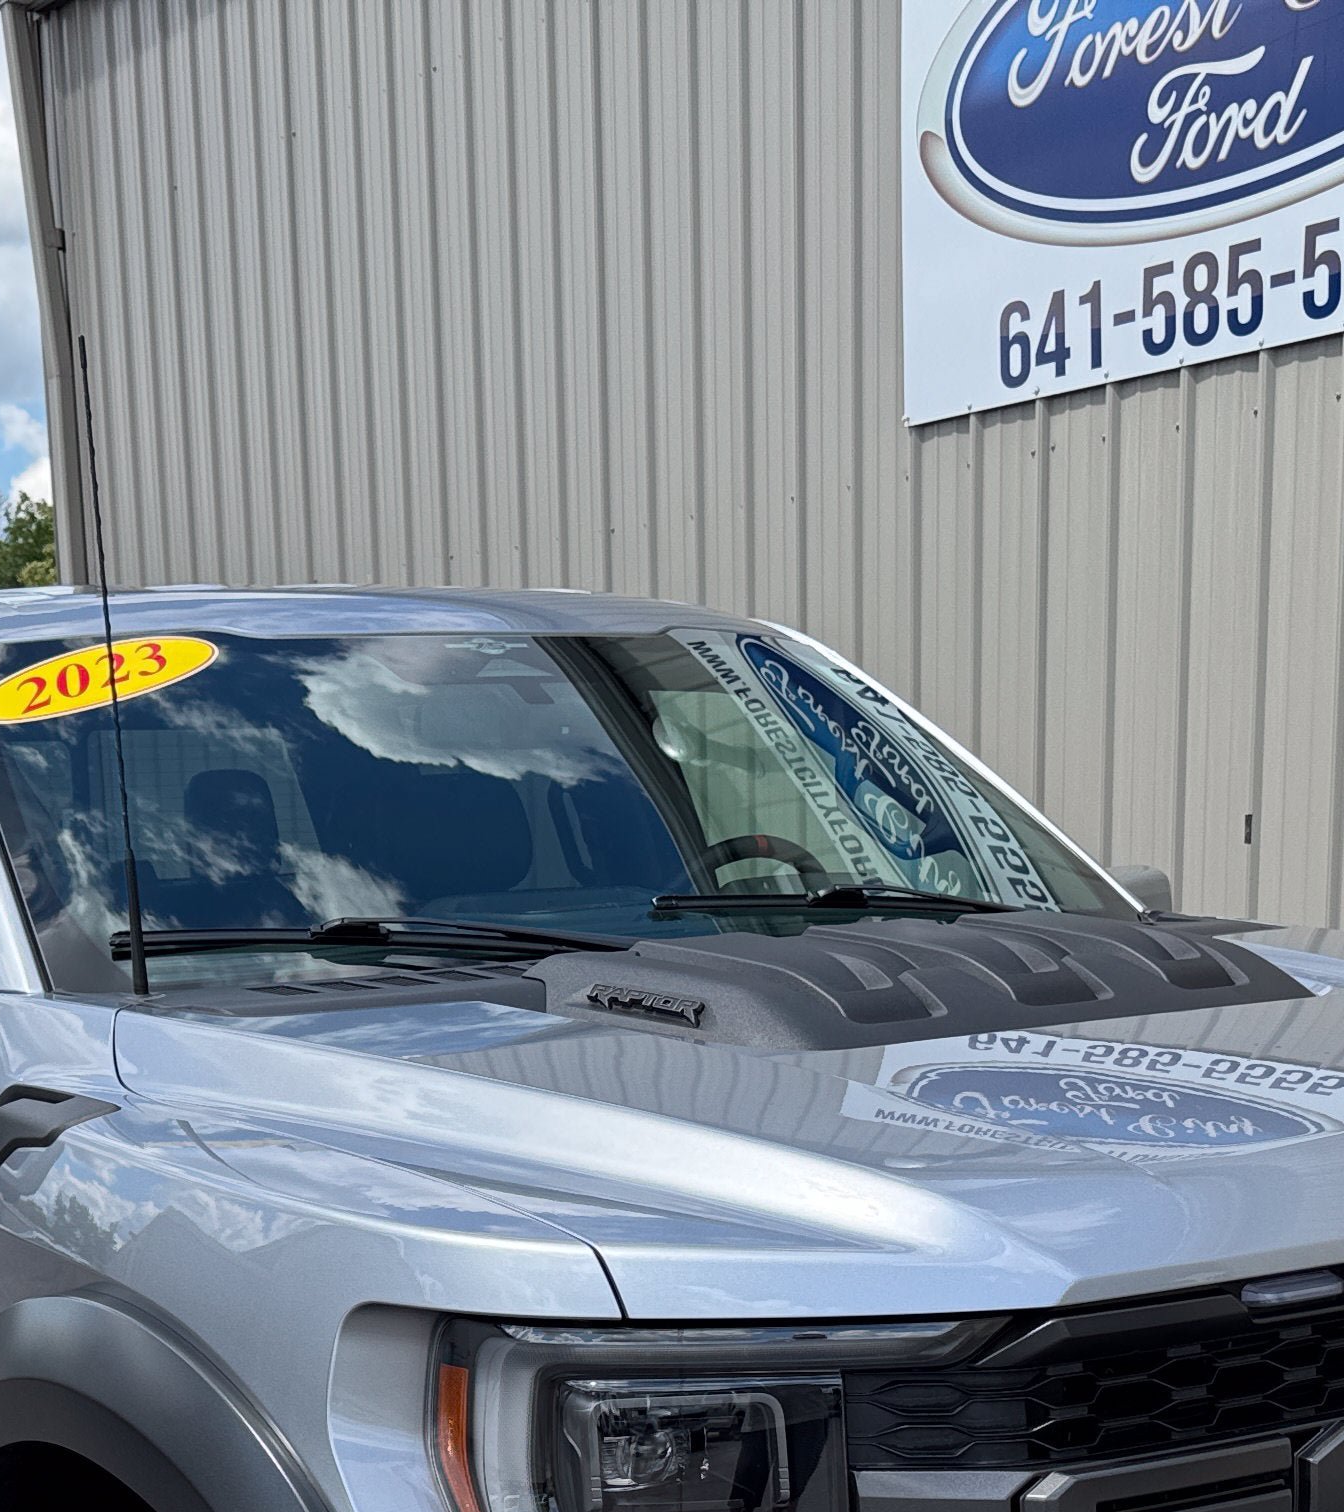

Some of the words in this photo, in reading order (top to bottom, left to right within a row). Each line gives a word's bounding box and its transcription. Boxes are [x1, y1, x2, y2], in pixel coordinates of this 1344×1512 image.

[1130, 46, 1315, 184] Ford
[17, 643, 167, 715] 2023
[588, 984, 706, 1028] RAPTOR
